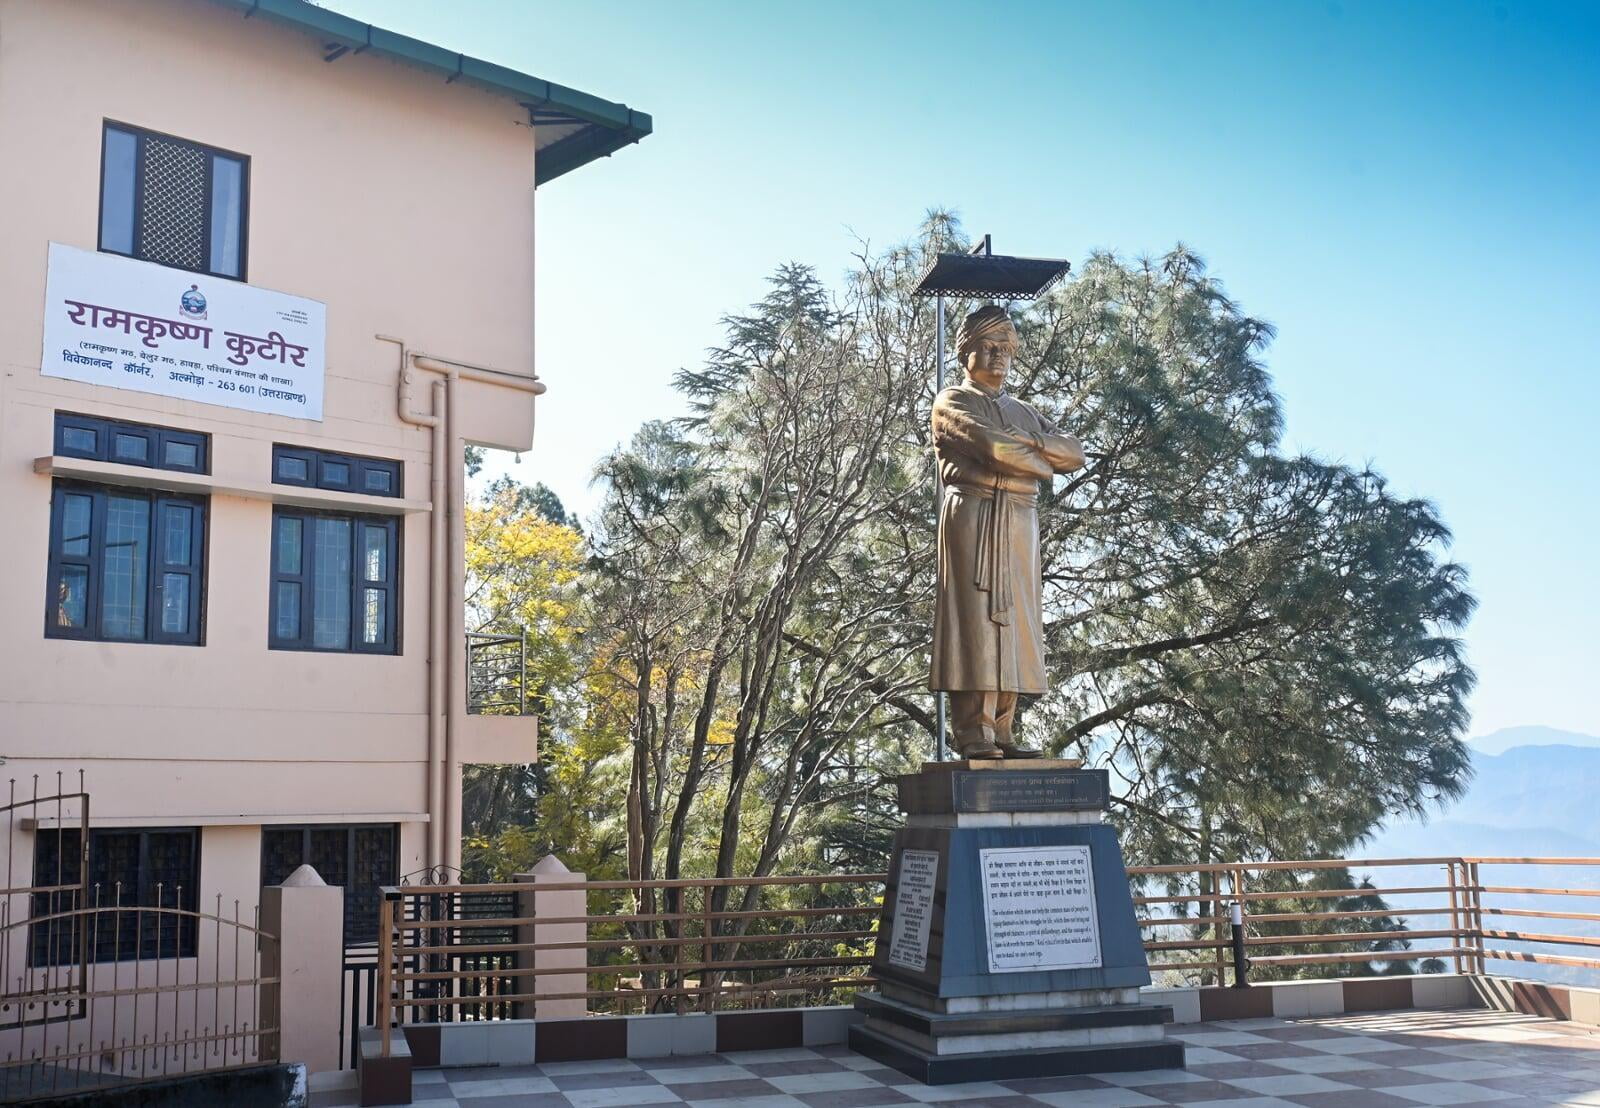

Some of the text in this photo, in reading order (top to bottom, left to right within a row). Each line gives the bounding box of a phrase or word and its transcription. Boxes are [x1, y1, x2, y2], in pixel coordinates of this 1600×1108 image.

[65, 299, 309, 367] रामकृष्ण कुटीर
[63, 349, 113, 370] विवेकानन्द
[124, 361, 154, 379] कॉर्नर,
[169, 371, 205, 388] अल्मोड़ा
[217, 380, 236, 391] 263
[239, 384, 255, 394] 601
[258, 385, 307, 405] (उत्तराखण्ड)
[79, 341, 118, 354] (रामकृष्ण
[120, 349, 137, 359] मठ,
[161, 356, 177, 366] मठ,
[206, 363, 232, 375] पश्चिम
[234, 368, 256, 379] बंगाल
[258, 373, 268, 381] की
[271, 376, 294, 387] शाखा)
